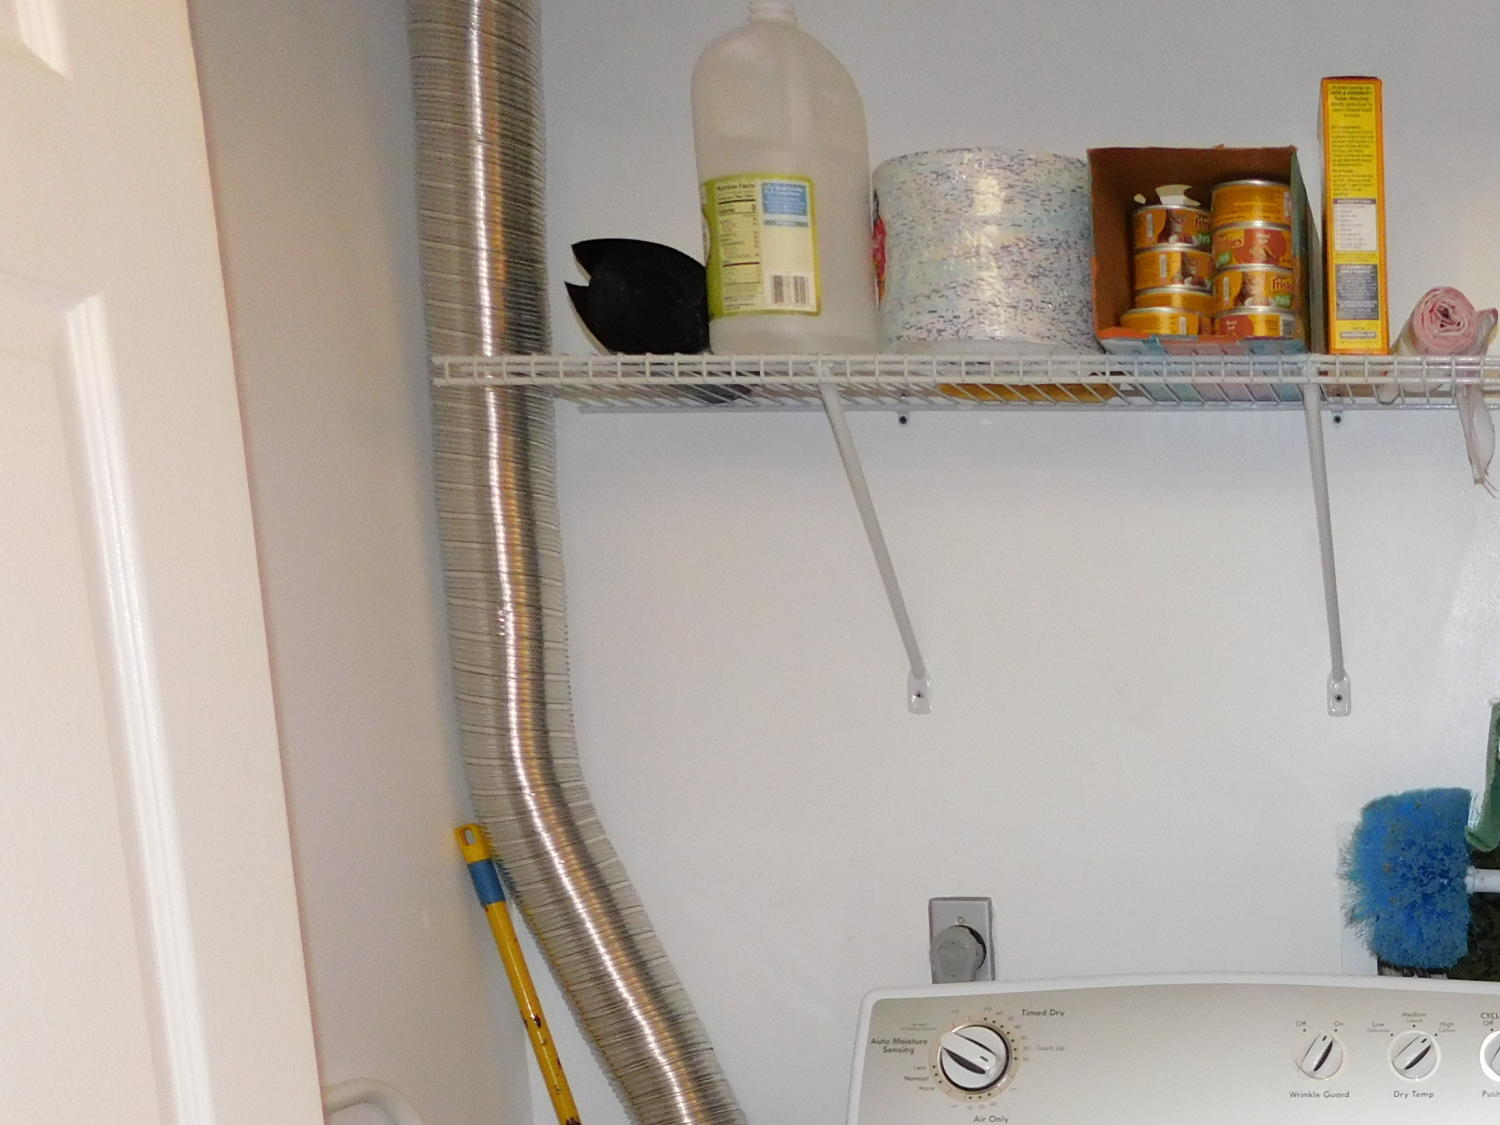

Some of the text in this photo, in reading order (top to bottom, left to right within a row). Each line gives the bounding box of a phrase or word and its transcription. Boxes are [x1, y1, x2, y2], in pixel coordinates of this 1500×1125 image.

[1021, 1009, 1065, 1018] Timed Dry
[870, 1037, 928, 1045] Auto Moisture
[882, 1046, 915, 1055] Sensing
[1393, 1091, 1435, 1099] Dry Temp
[973, 1115, 1009, 1124] Air Only
